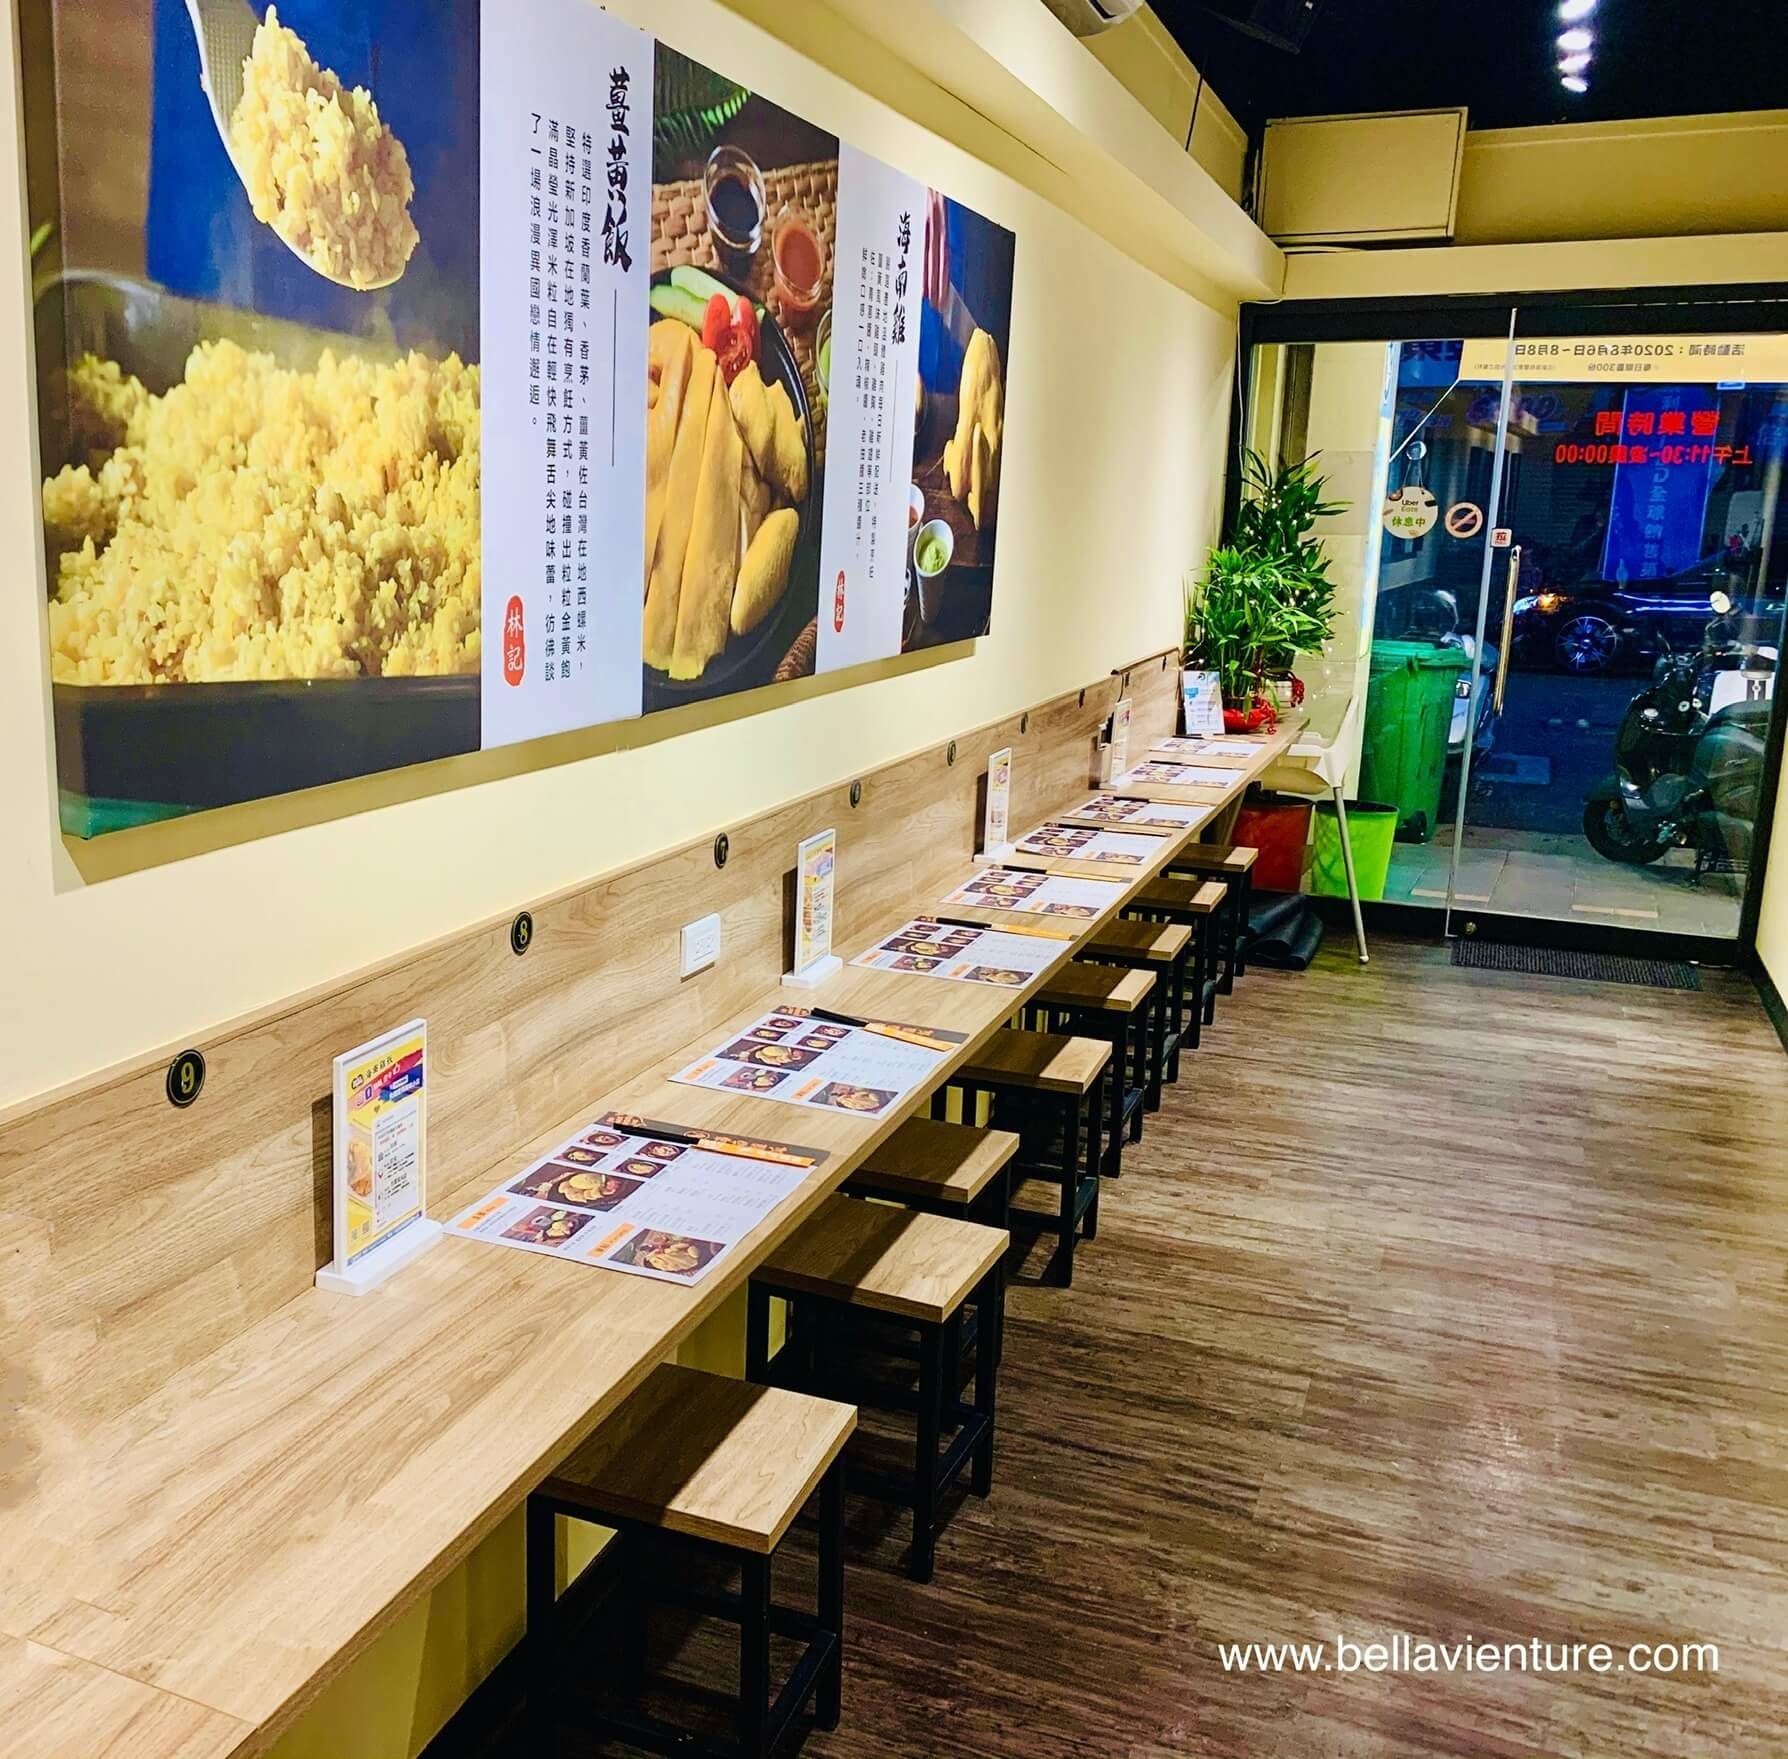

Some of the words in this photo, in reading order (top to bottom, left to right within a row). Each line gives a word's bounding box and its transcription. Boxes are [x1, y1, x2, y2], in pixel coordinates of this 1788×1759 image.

[600, 65, 633, 273] 薑黃飯
[1391, 515, 1426, 528] 休息中
[505, 605, 524, 673] 林記
[520, 920, 528, 945] 8
[181, 1061, 195, 1094] 9
